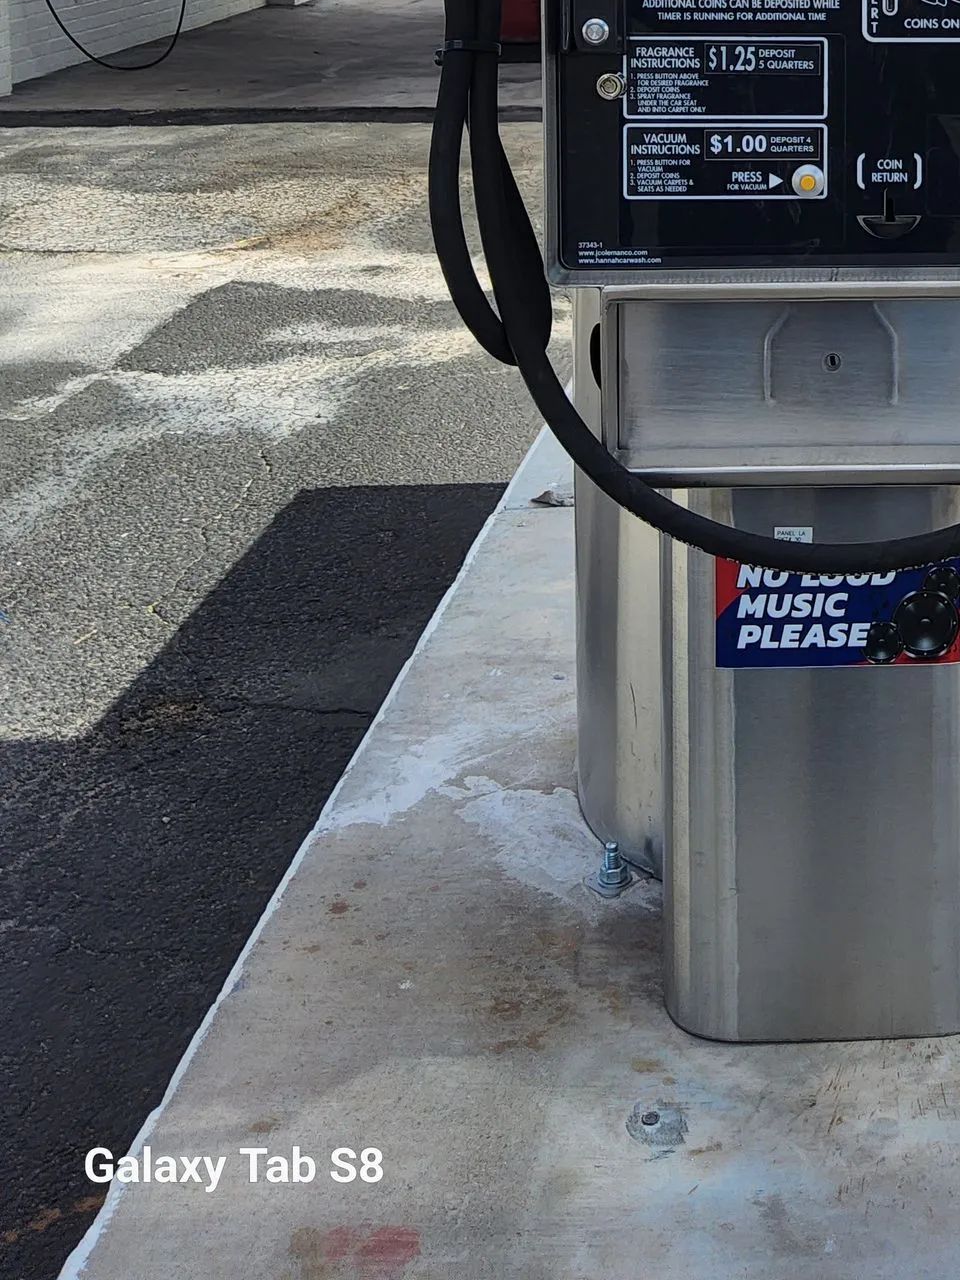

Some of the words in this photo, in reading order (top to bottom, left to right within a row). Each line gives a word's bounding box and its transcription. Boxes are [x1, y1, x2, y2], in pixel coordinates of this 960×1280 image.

[658, 12, 682, 20] TIMER
[683, 12, 691, 20] IS
[694, 12, 735, 20] RUNNING
[737, 12, 753, 20] FOR
[754, 12, 806, 20] ADDITIONAL
[808, 12, 826, 20] TIME
[904, 18, 939, 28] COINS
[636, 47, 694, 57] FRAGRANCE
[759, 49, 796, 58] DEPOSIT
[631, 58, 700, 68] INSTRUCTIONS
[708, 46, 756, 71] $1.25
[758, 60, 764, 70] 5
[767, 60, 814, 70] QUARTERS
[643, 134, 687, 143] VACUUM
[710, 134, 767, 154] $1.00
[631, 145, 700, 154] INSTRUCTIONS
[877, 159, 902, 169] COIN
[732, 172, 762, 182] PRESS
[872, 173, 908, 182] RETURN
[736, 564, 787, 588] NO
[736, 593, 848, 618] MUSIC
[736, 623, 871, 648] PLEASE
